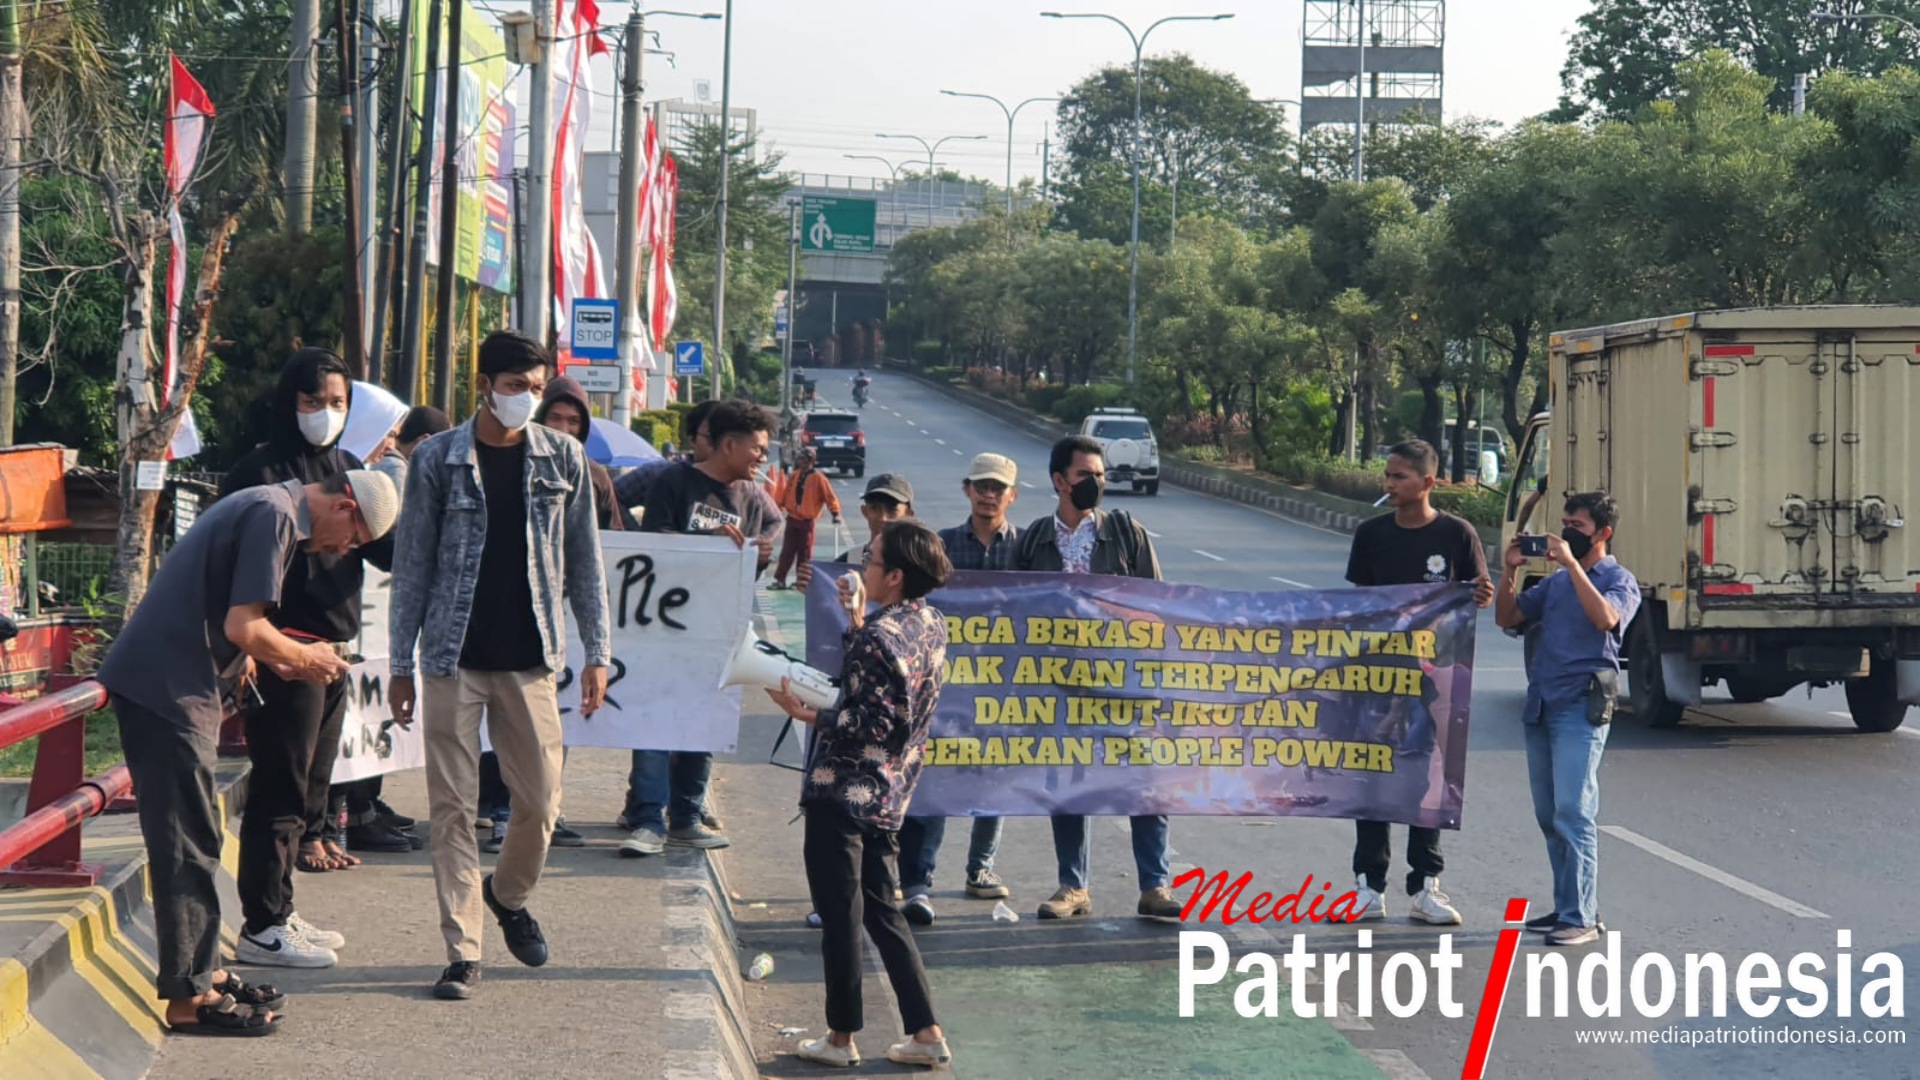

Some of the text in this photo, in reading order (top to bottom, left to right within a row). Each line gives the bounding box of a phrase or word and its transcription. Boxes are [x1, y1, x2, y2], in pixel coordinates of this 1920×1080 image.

[576, 329, 612, 342] STOP
[695, 504, 738, 525] ASPEN
[609, 554, 690, 630] Ple
[944, 616, 1437, 660] RGA BEKASI YANG PINTAR
[1012, 656, 1126, 689] AKAN
[1134, 659, 1423, 697] TERPENGARUH
[973, 695, 1318, 728] DAN IKUT-IKUTAN
[1103, 736, 1244, 767] PEOPLE
[1252, 737, 1394, 774] POWER
